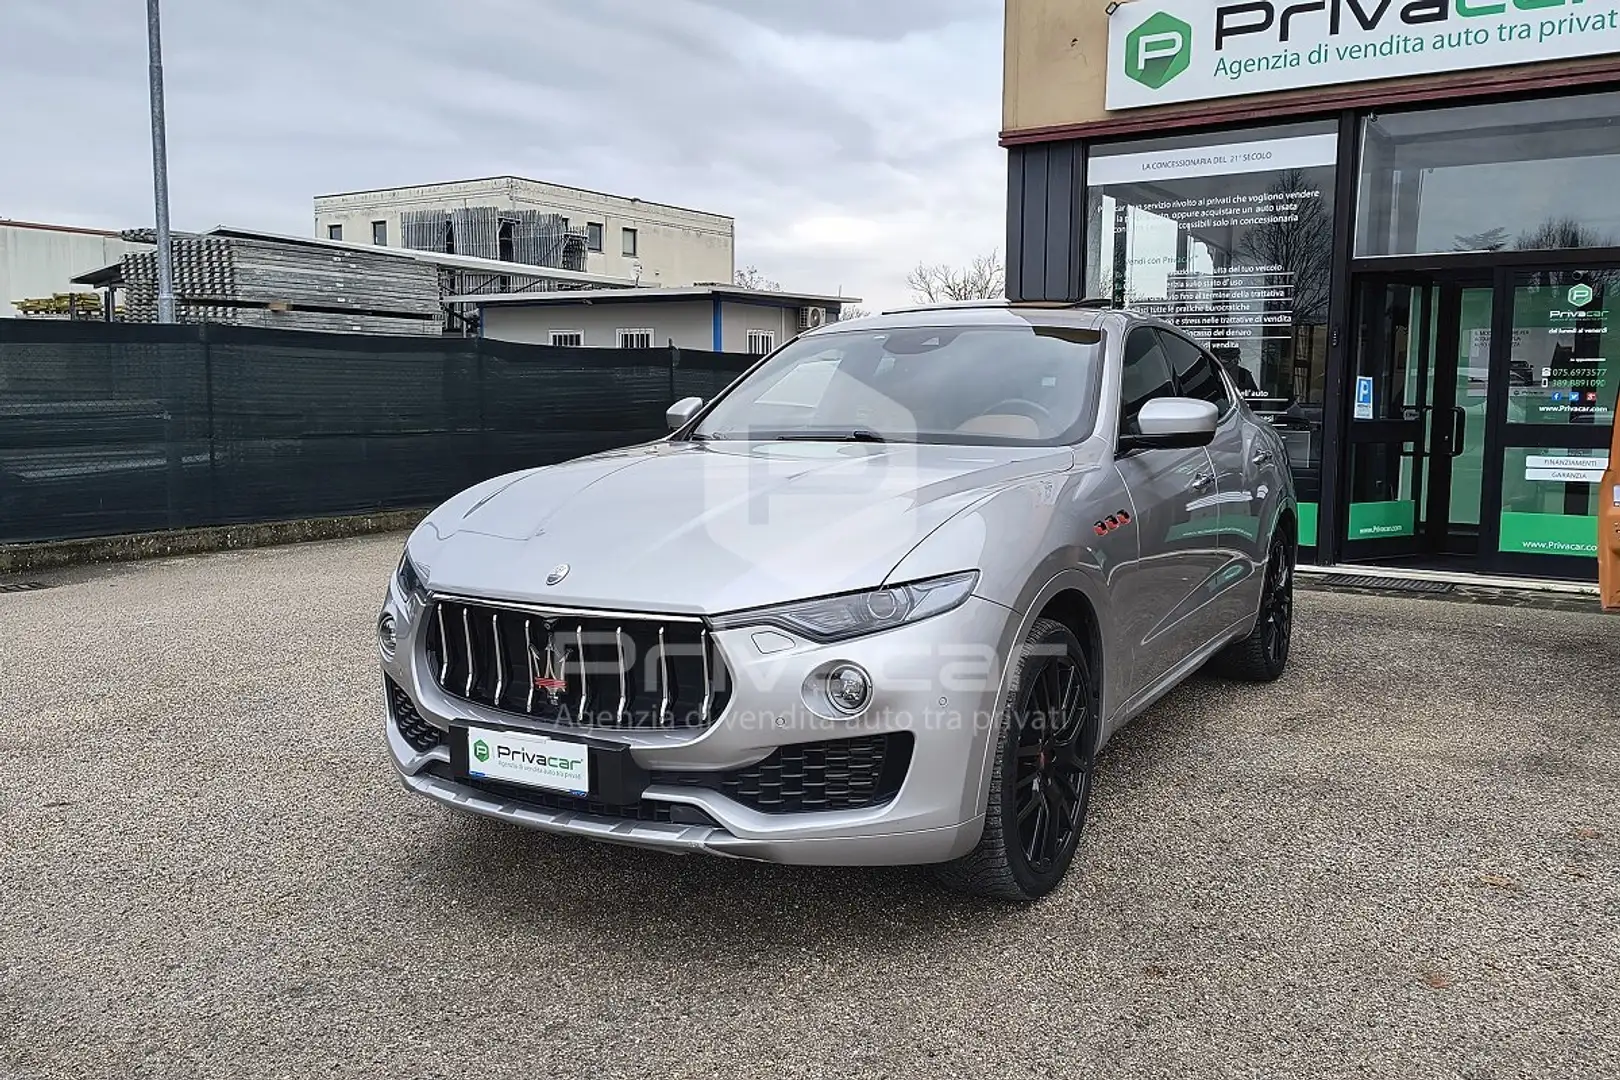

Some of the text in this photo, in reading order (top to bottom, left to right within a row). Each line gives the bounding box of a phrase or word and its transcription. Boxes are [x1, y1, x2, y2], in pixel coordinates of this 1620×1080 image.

[1215, 0, 1588, 50] Priva
[1213, 49, 1301, 80] Agenzia
[1308, 43, 1329, 65] di
[1336, 34, 1425, 61] vendita
[1432, 27, 1489, 50] auto
[1497, 22, 1531, 42] tra
[1142, 163, 1151, 171] LA
[1151, 157, 1212, 170] CONCESSIONARIA
[1213, 156, 1227, 165] DEL
[1243, 151, 1273, 162] SECOLO
[1206, 195, 1232, 207] privati
[1232, 194, 1247, 204] che
[1248, 192, 1284, 204] vogliono
[1285, 189, 1320, 200] vendere
[1171, 208, 1200, 220] oppure
[1201, 206, 1241, 218] acquistare
[1242, 206, 1253, 214] un
[1256, 204, 1275, 212] auto
[1276, 202, 1299, 211] usata
[1212, 218, 1229, 227] solo
[1239, 213, 1299, 226] concessionaria
[1250, 288, 1285, 298] trattativa
[1264, 314, 1292, 322] vendita
[1549, 309, 1609, 318] Privacar
[1212, 340, 1239, 348] vendita
[1552, 368, 1608, 377] 075.6973577
[1539, 405, 1608, 413] www.Privacar.com
[1544, 458, 1597, 467] FINANZIAMENTI
[497, 745, 582, 771] Privacar
